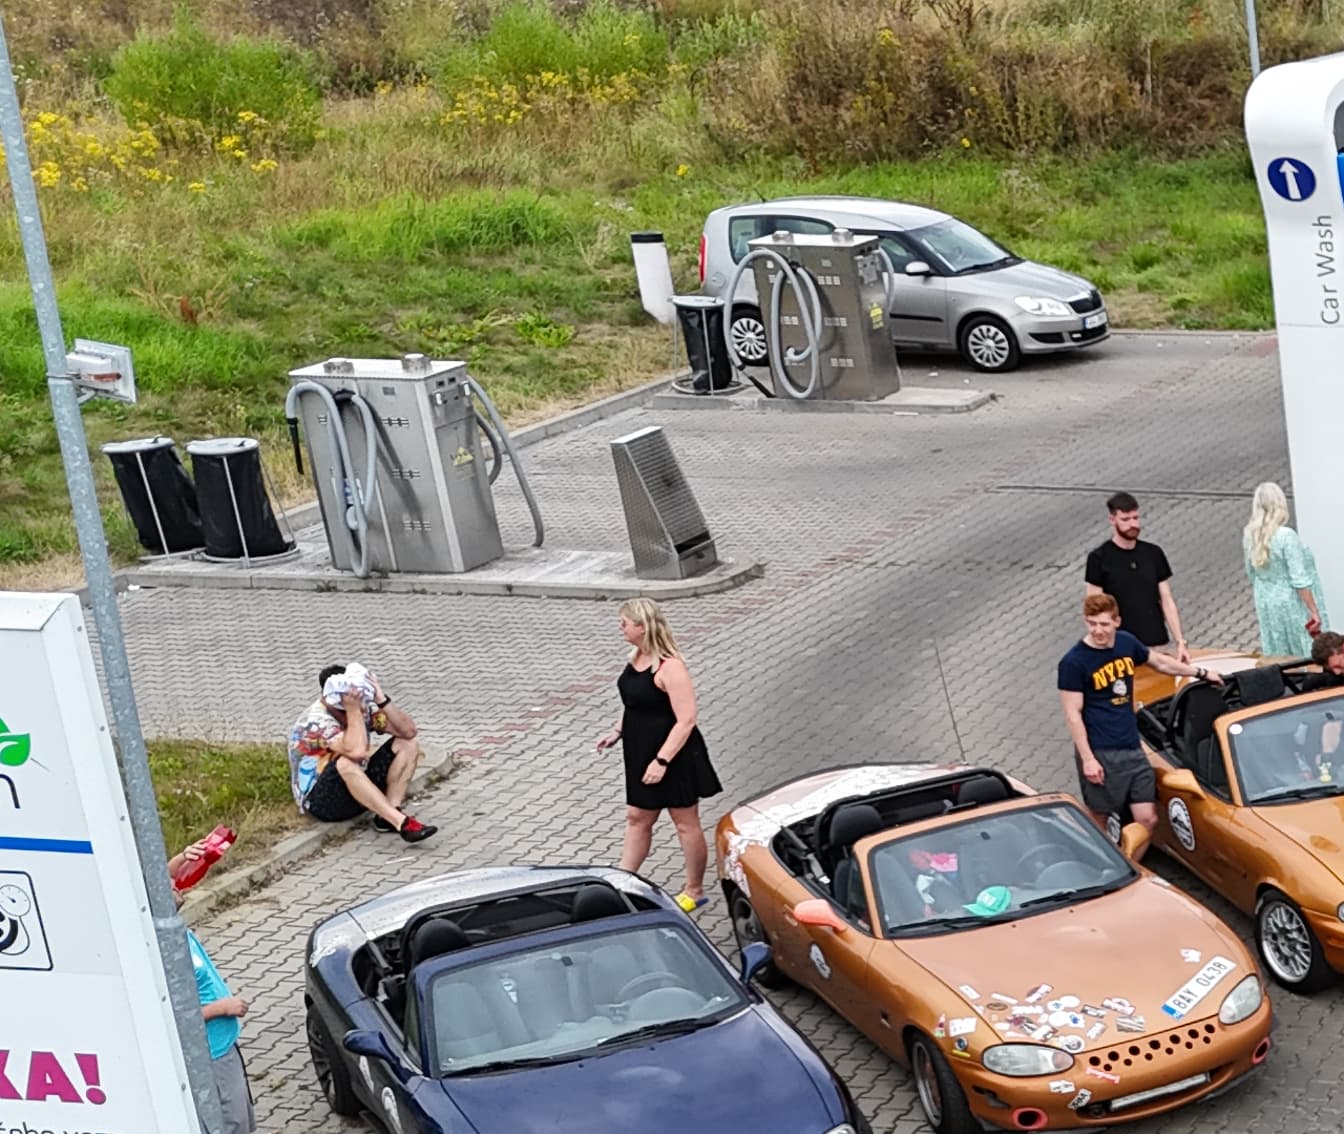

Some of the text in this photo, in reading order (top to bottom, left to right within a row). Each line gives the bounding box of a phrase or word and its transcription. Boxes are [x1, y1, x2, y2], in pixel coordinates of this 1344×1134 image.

[1312, 215, 1340, 325] Car Wash
[1172, 961, 1228, 1010] 8AY 0438
